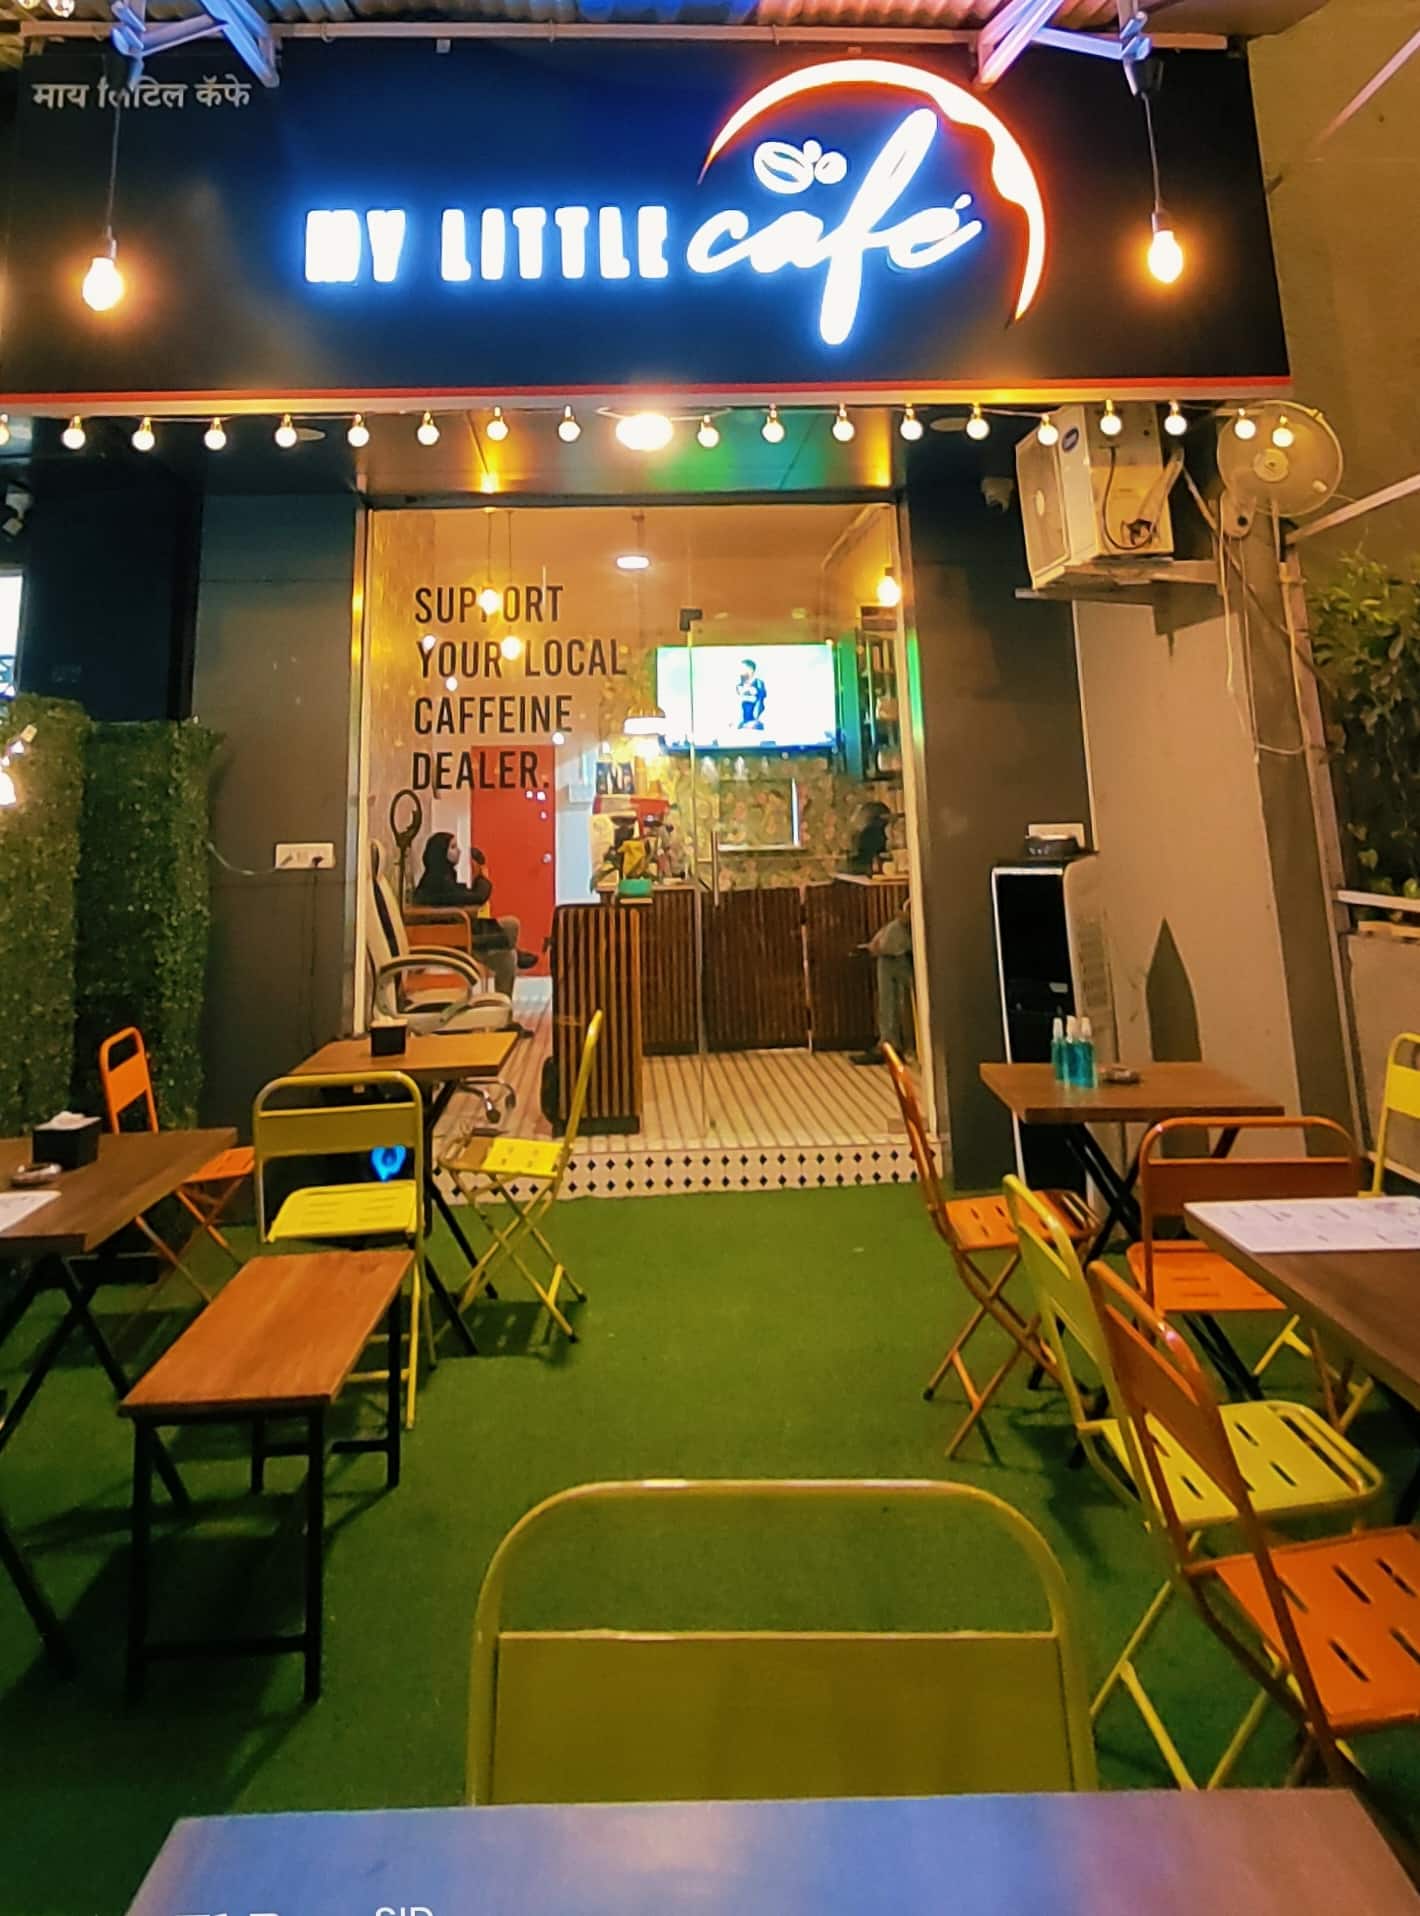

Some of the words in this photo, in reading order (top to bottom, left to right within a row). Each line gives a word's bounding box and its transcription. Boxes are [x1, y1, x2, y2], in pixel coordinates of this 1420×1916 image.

[32, 82, 90, 108] माय
[440, 205, 669, 282] LITTLE
[417, 639, 503, 678] YOUR
[524, 638, 628, 676] LOCAL
[414, 695, 573, 735] CAFFEINE
[412, 750, 549, 790] DEALER.
